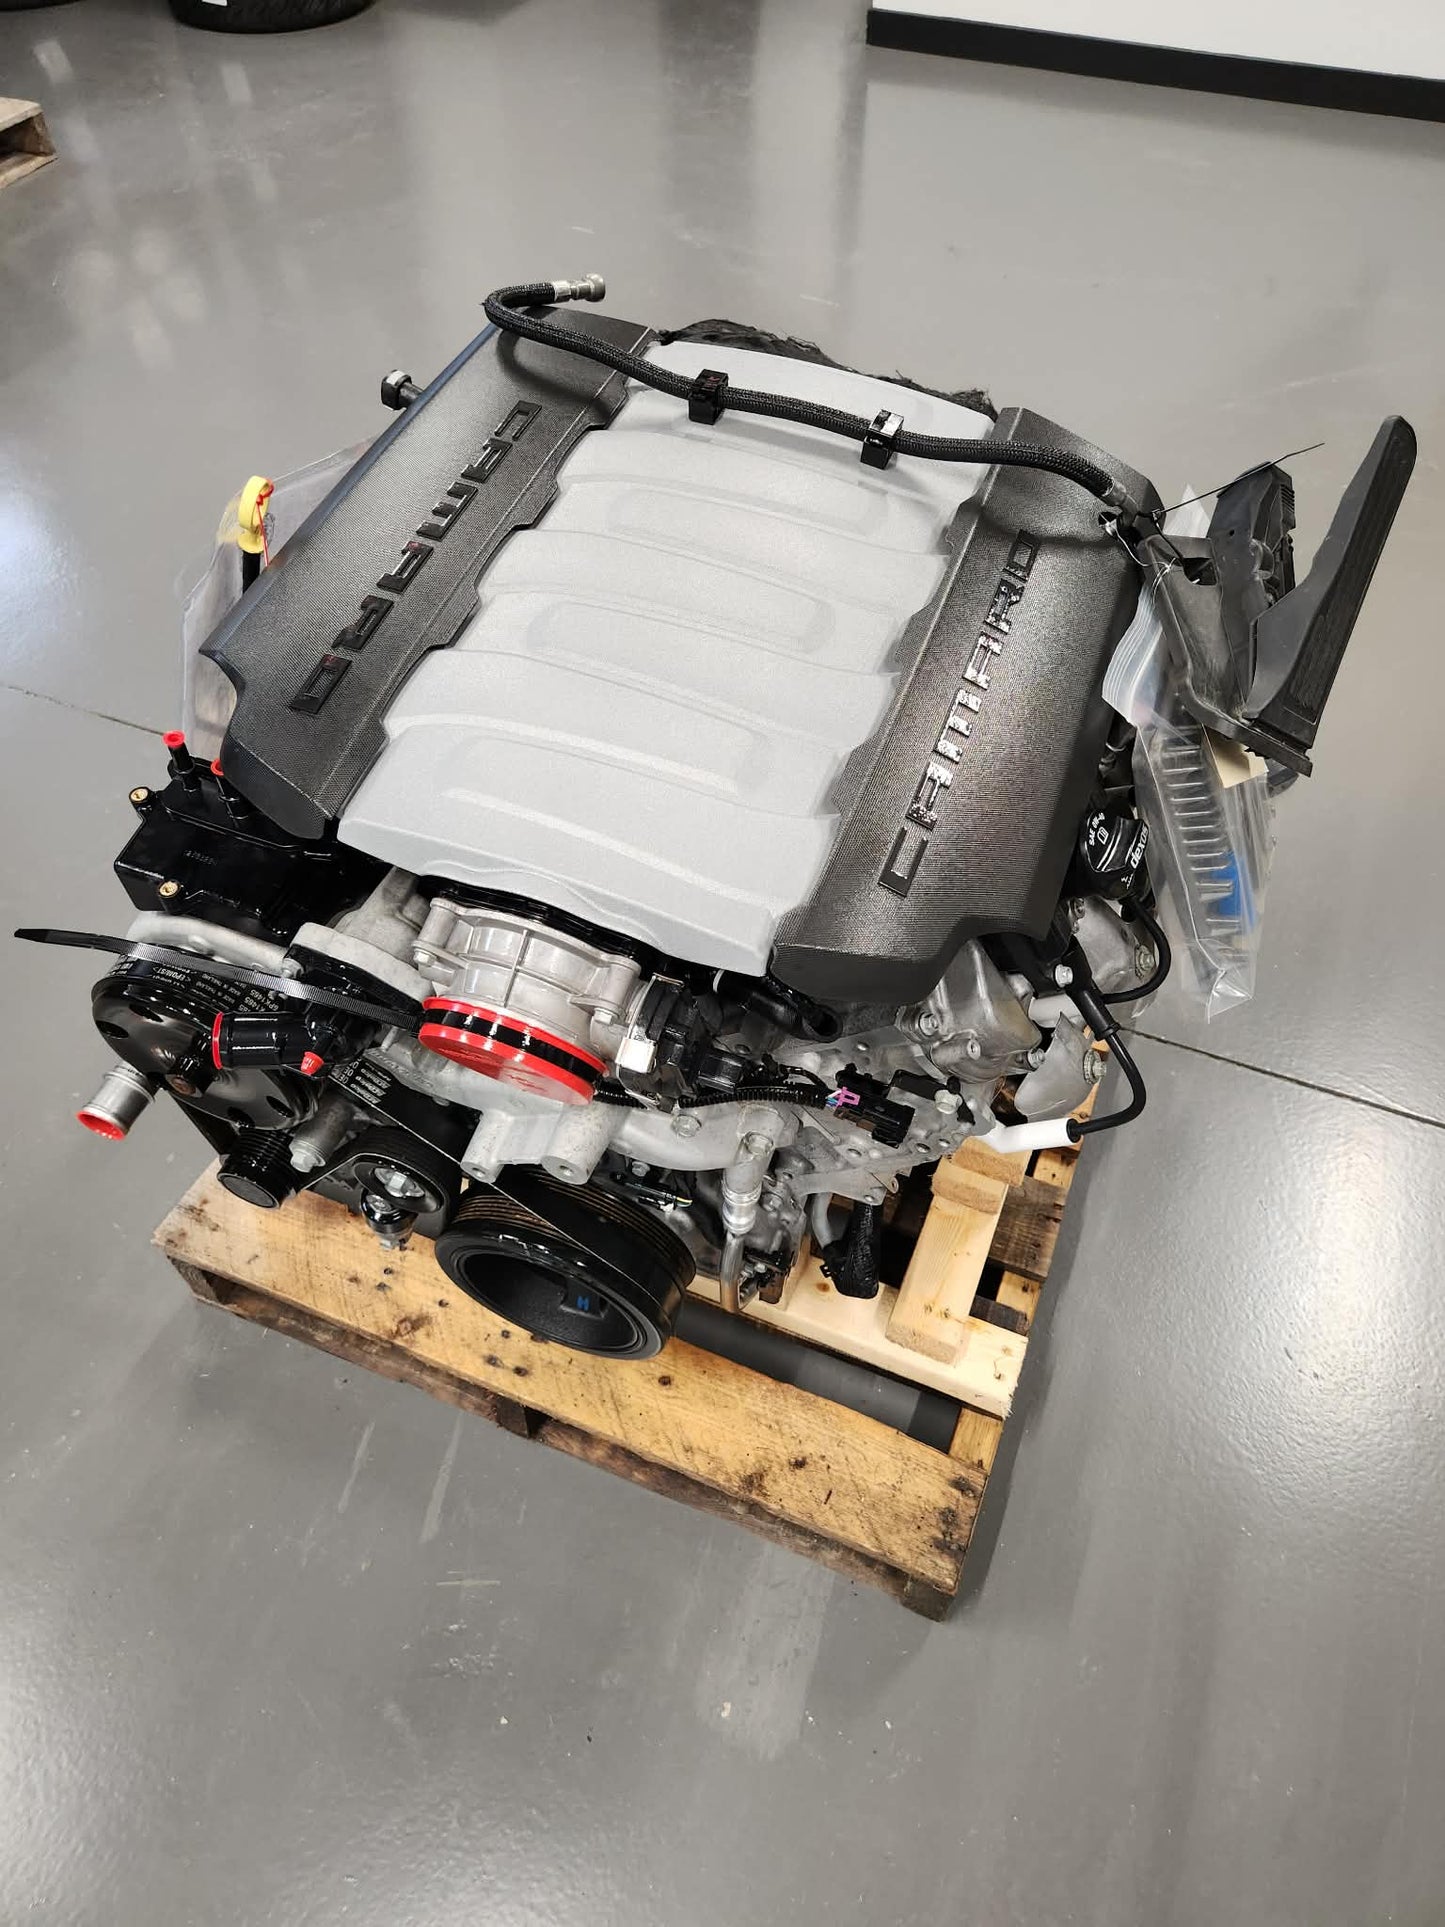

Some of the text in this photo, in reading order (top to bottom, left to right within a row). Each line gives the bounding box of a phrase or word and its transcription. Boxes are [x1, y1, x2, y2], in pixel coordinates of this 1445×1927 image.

[289, 400, 542, 714] CAMARO
[877, 529, 1041, 897] CAMARO
[1130, 824, 1149, 869] dexos
